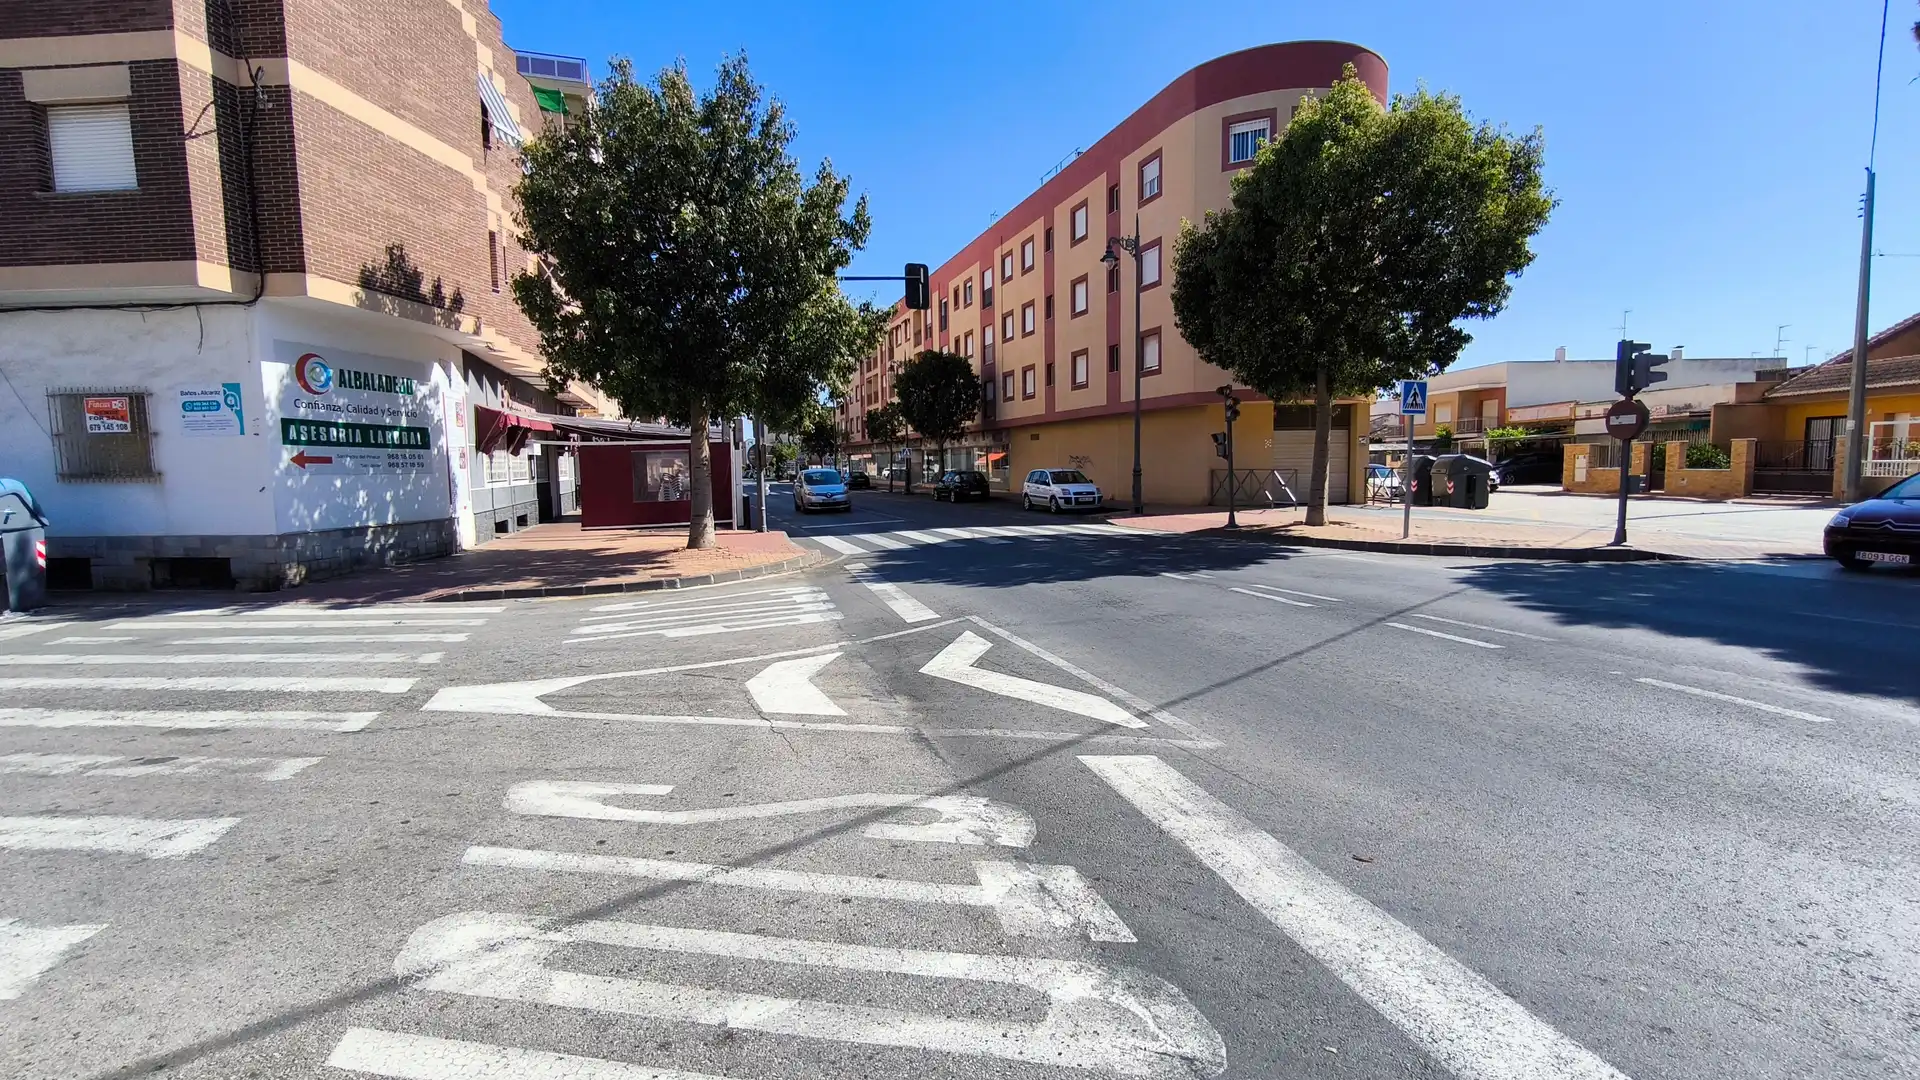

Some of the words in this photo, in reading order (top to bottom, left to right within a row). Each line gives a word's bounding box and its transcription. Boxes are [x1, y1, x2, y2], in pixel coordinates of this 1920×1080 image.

[338, 368, 414, 395] ALBALADEJO
[293, 398, 344, 414] Confianza,
[346, 403, 379, 415] Calidad
[380, 408, 386, 418] y
[387, 407, 418, 419] Servicio
[289, 424, 362, 443] ASESORIA
[369, 429, 422, 445] LABORAL
